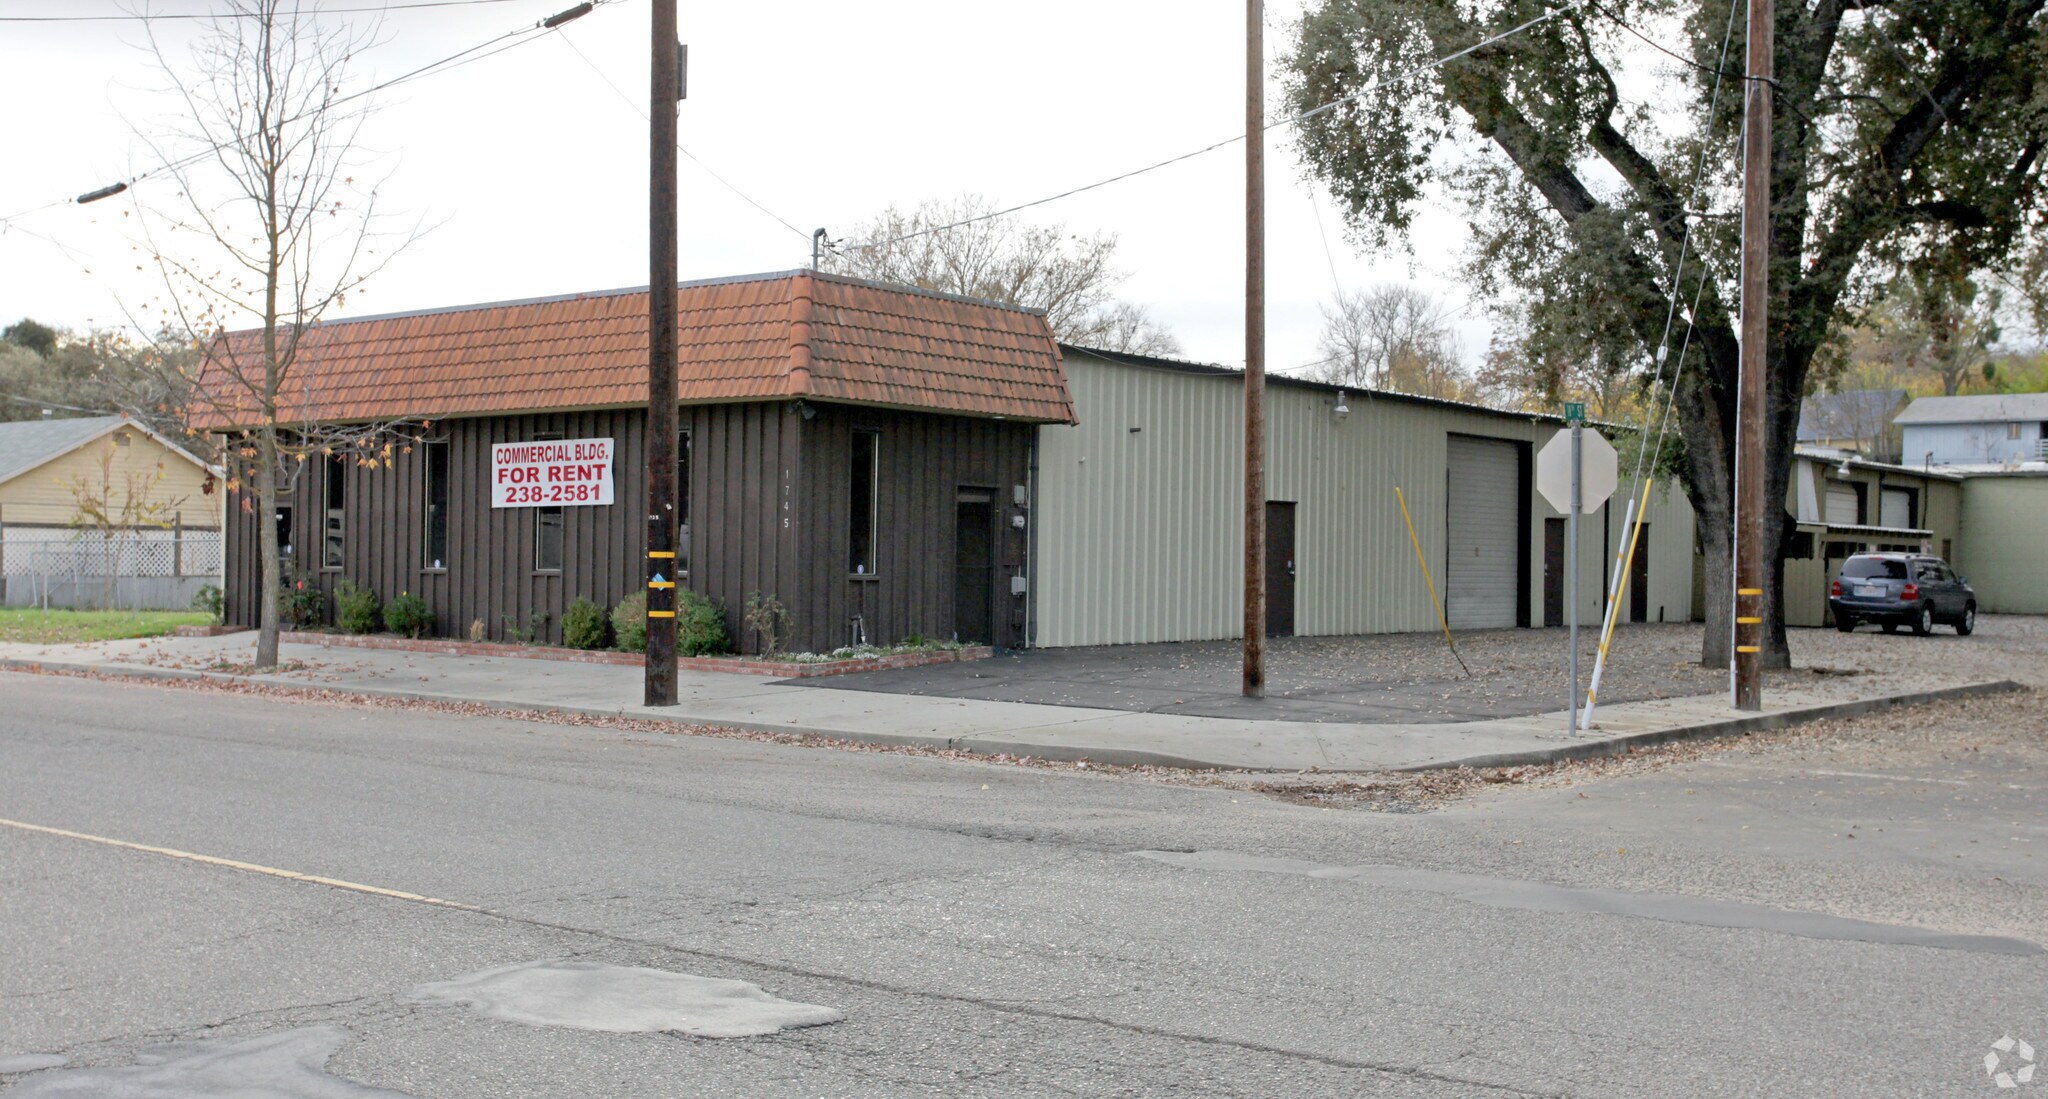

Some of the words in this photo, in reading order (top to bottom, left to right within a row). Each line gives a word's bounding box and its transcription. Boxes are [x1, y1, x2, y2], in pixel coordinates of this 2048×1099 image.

[496, 445, 572, 465] COMMERCIAL
[575, 443, 609, 461] BLDG.
[498, 466, 540, 484] FOR
[548, 464, 607, 482] RENT
[505, 484, 600, 503] 238-2581
